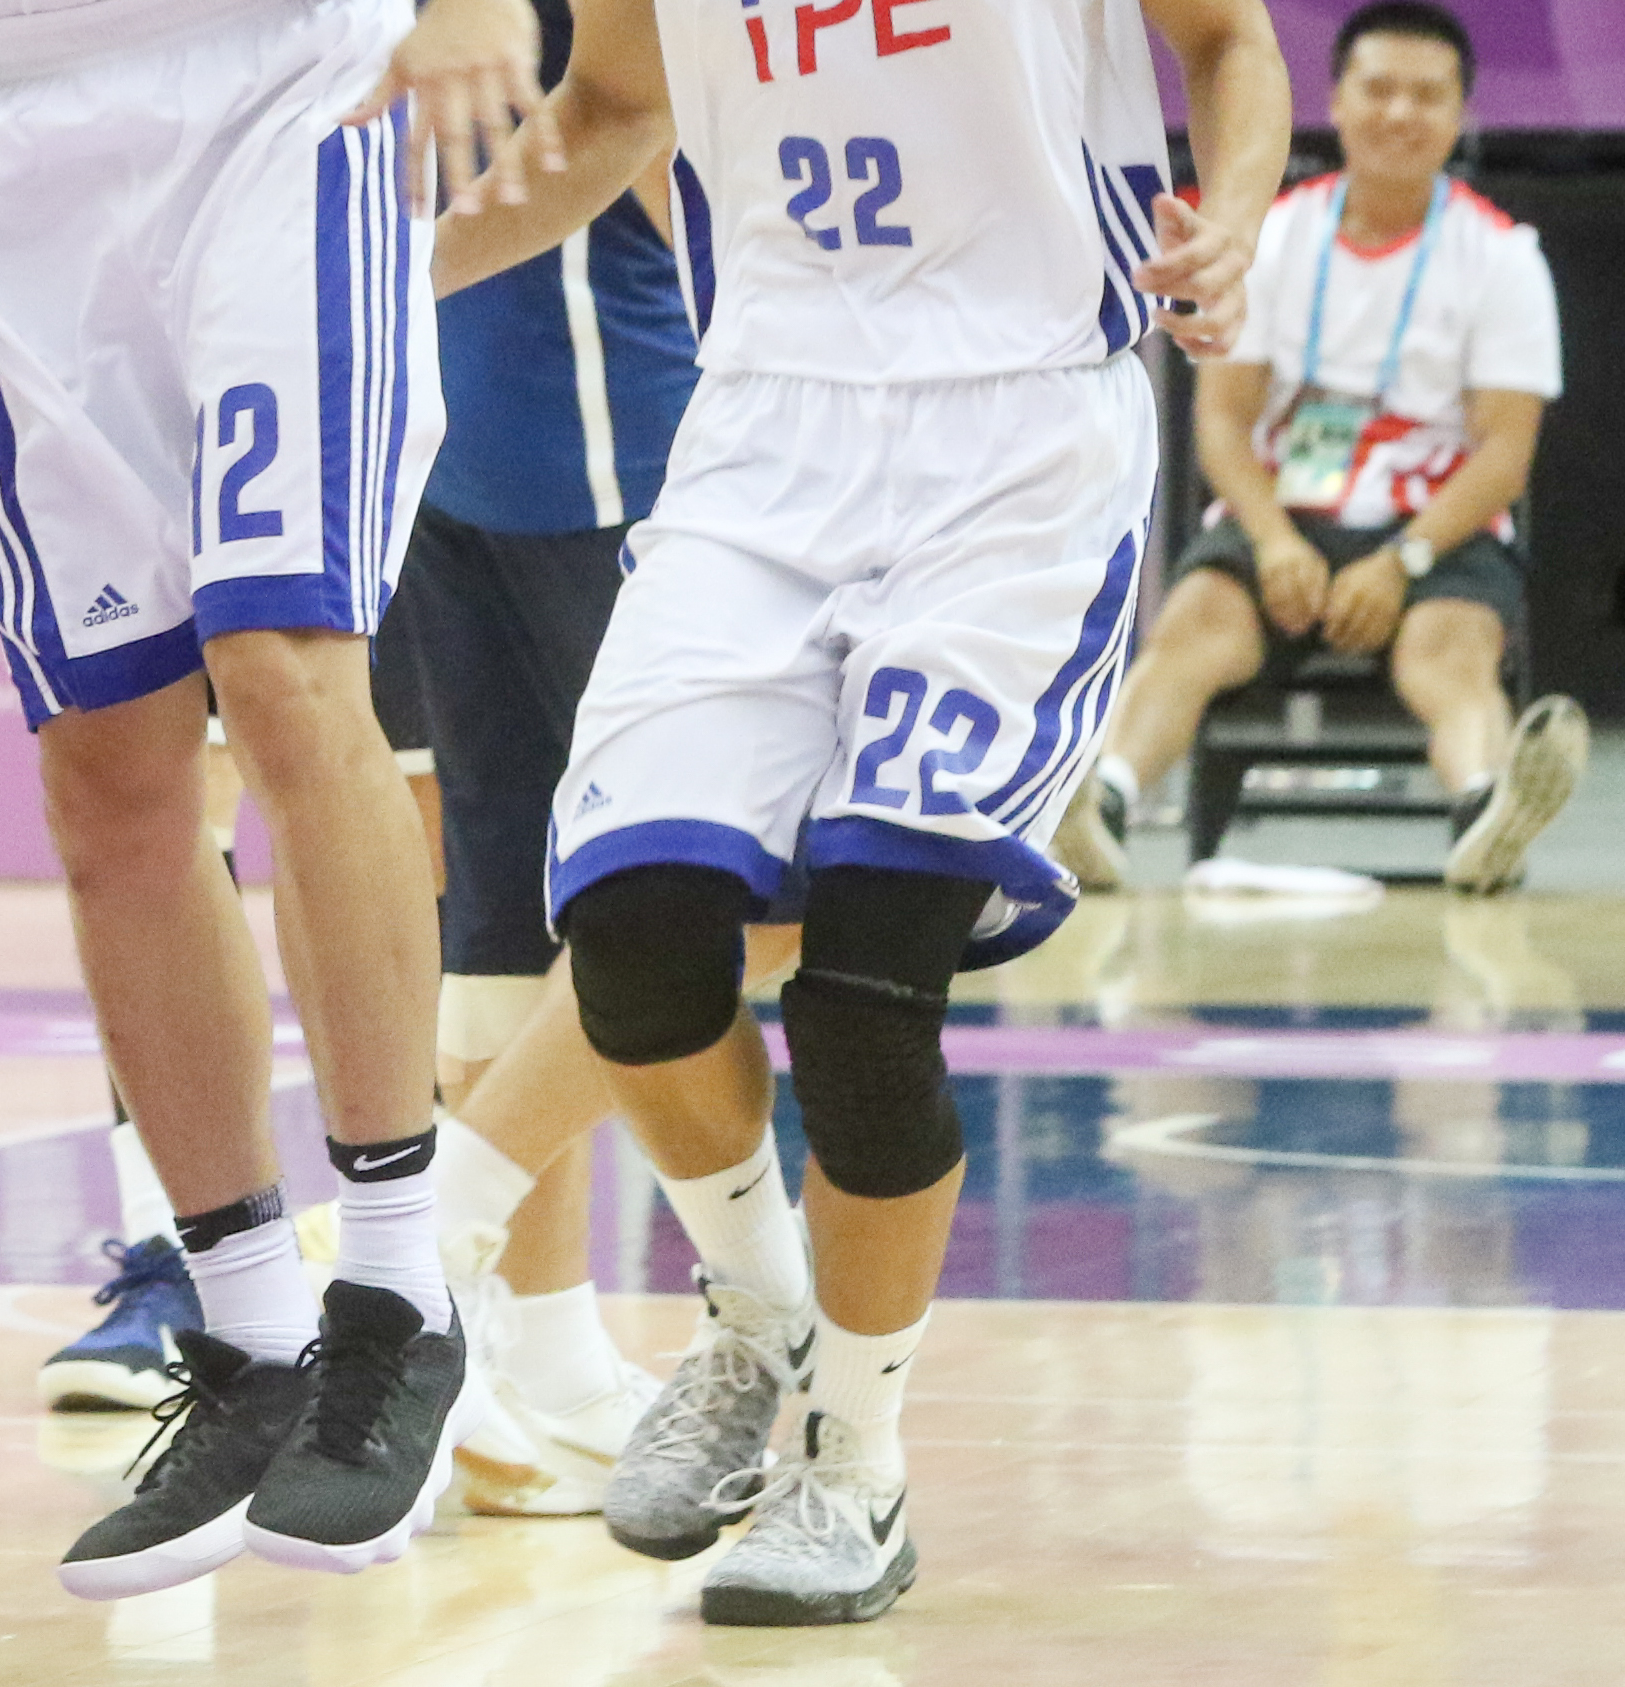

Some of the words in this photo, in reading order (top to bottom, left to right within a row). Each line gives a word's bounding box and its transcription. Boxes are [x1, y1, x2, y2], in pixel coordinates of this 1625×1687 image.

[778, 135, 913, 251] 22
[82, 602, 140, 628] adidas
[850, 666, 1001, 815] 22
